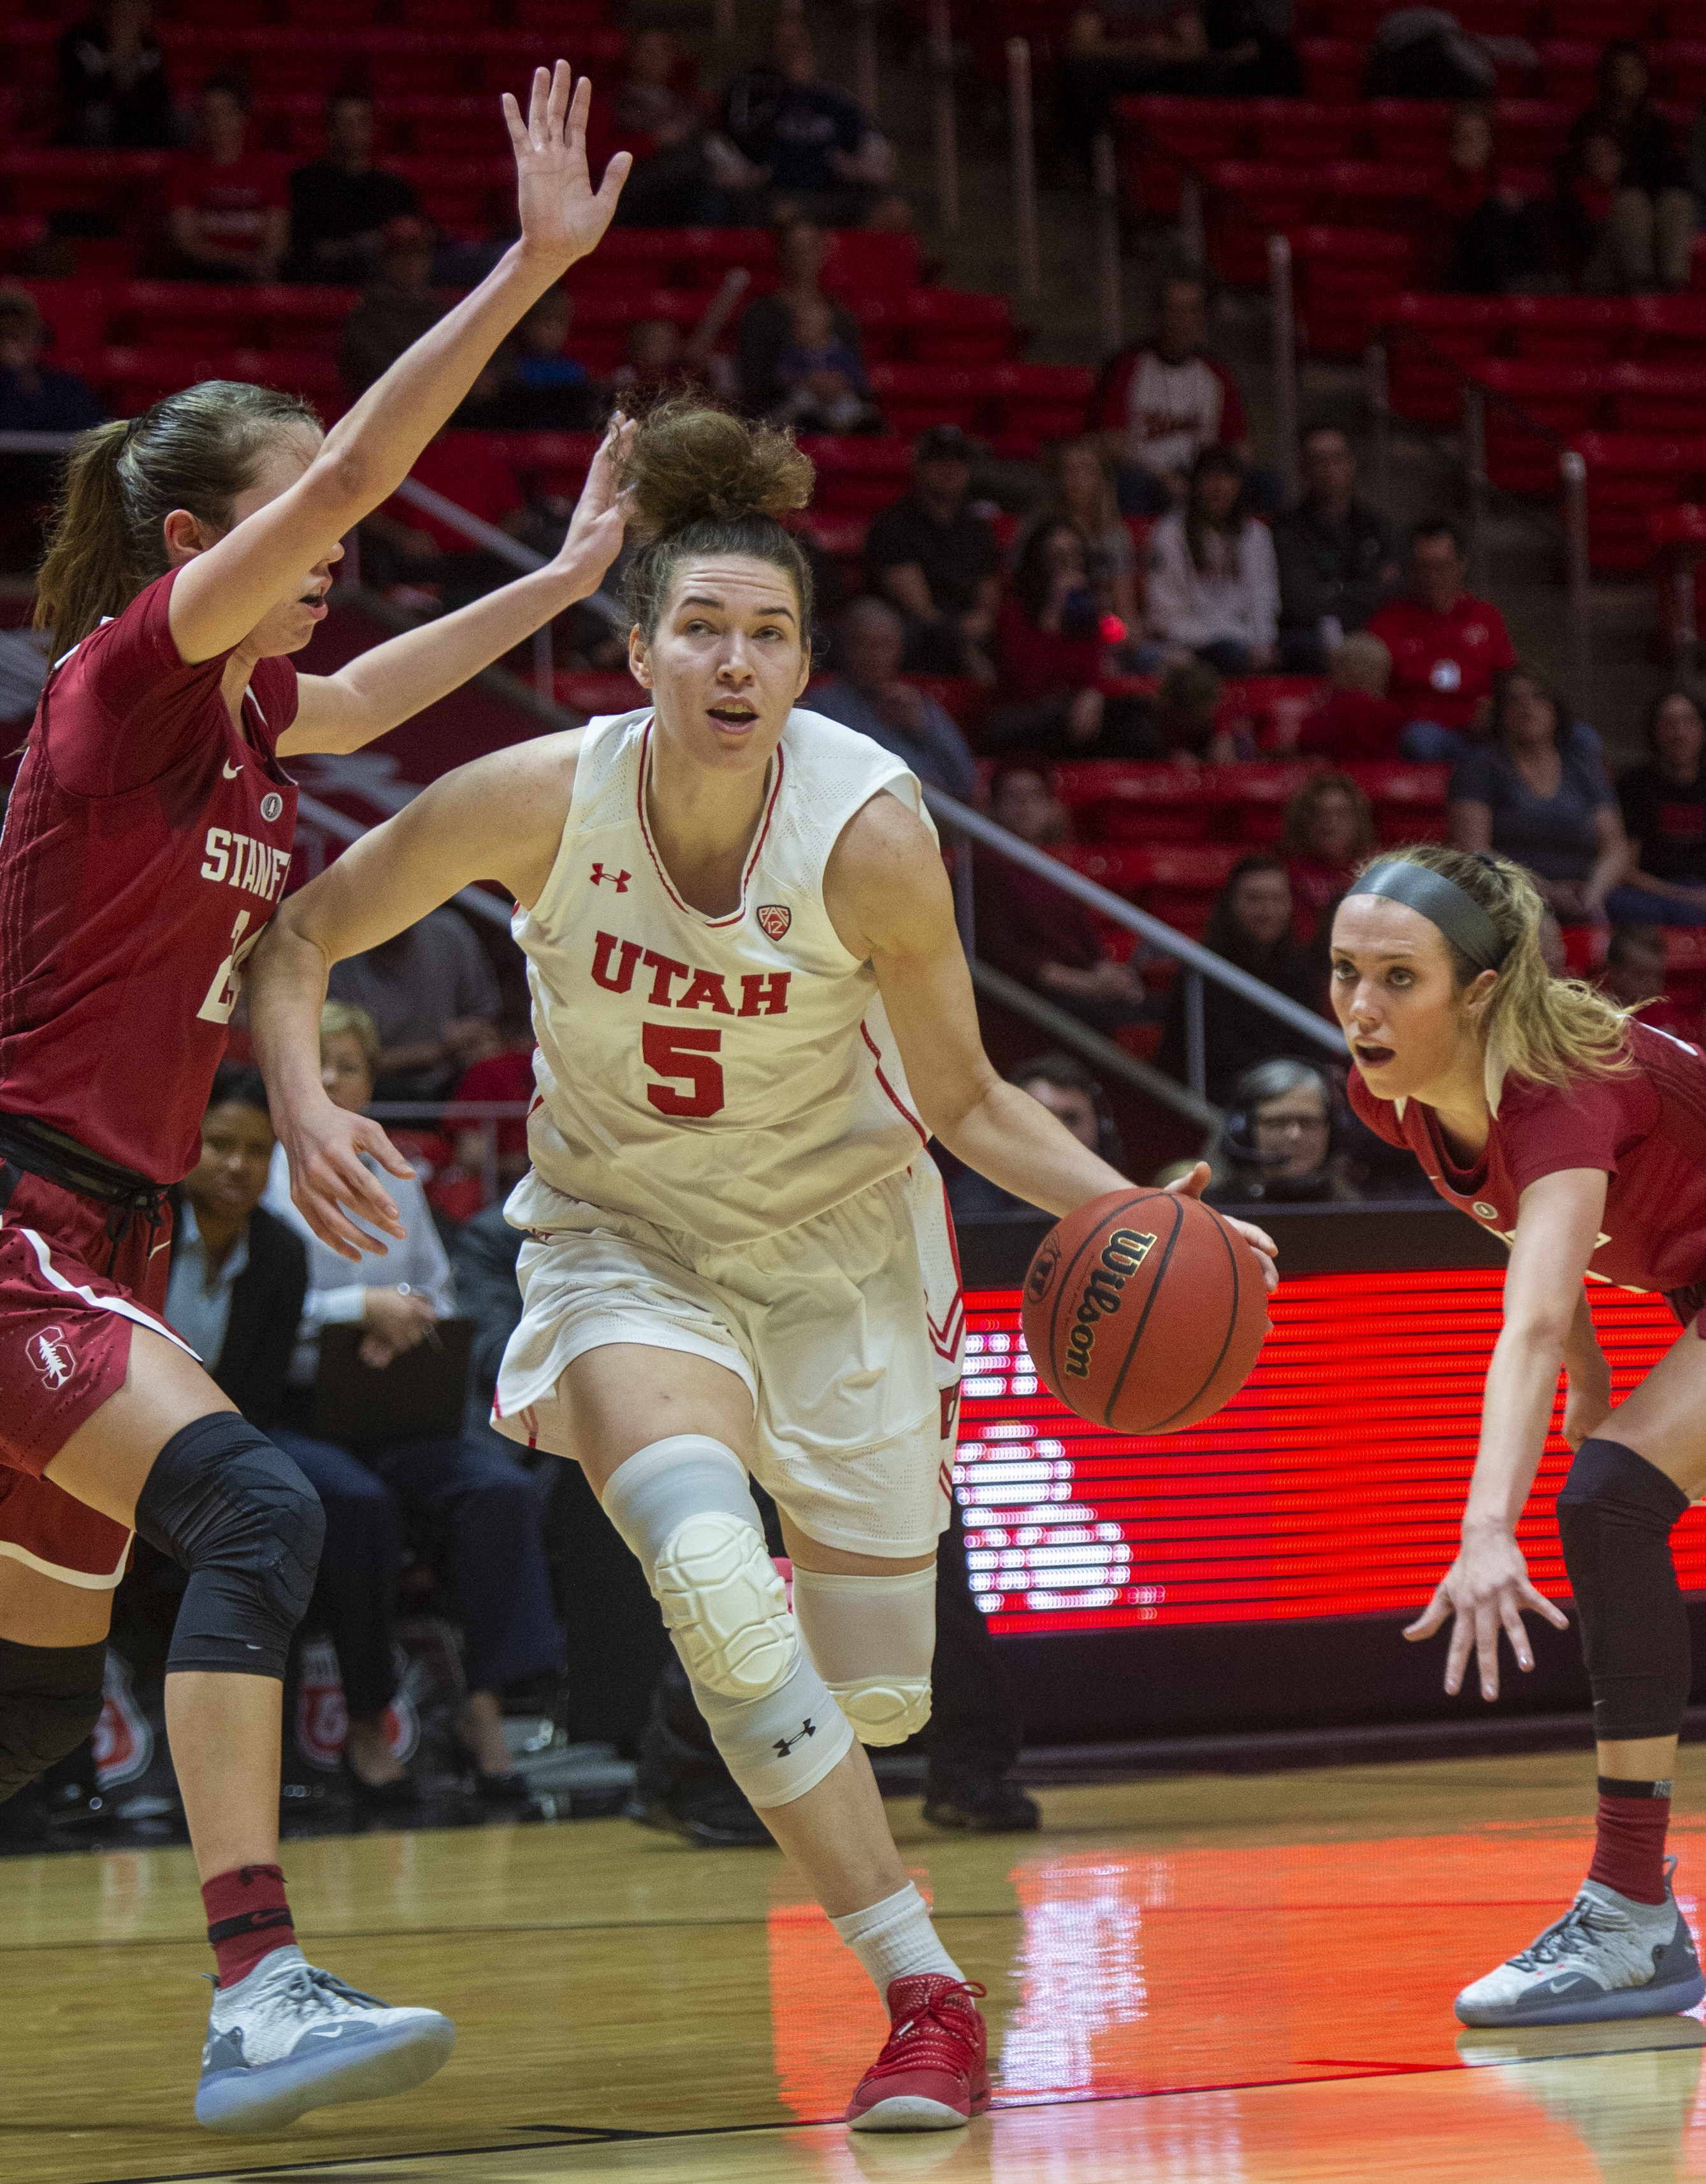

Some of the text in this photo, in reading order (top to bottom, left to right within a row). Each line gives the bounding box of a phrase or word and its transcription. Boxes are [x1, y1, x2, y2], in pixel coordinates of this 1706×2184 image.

[201, 827, 291, 904] STANF
[758, 907, 790, 927] PAC
[767, 921, 784, 934] 12
[591, 930, 792, 1017] UTAH
[642, 1021, 725, 1117] 5
[1064, 1227, 1158, 1379] Wilson
